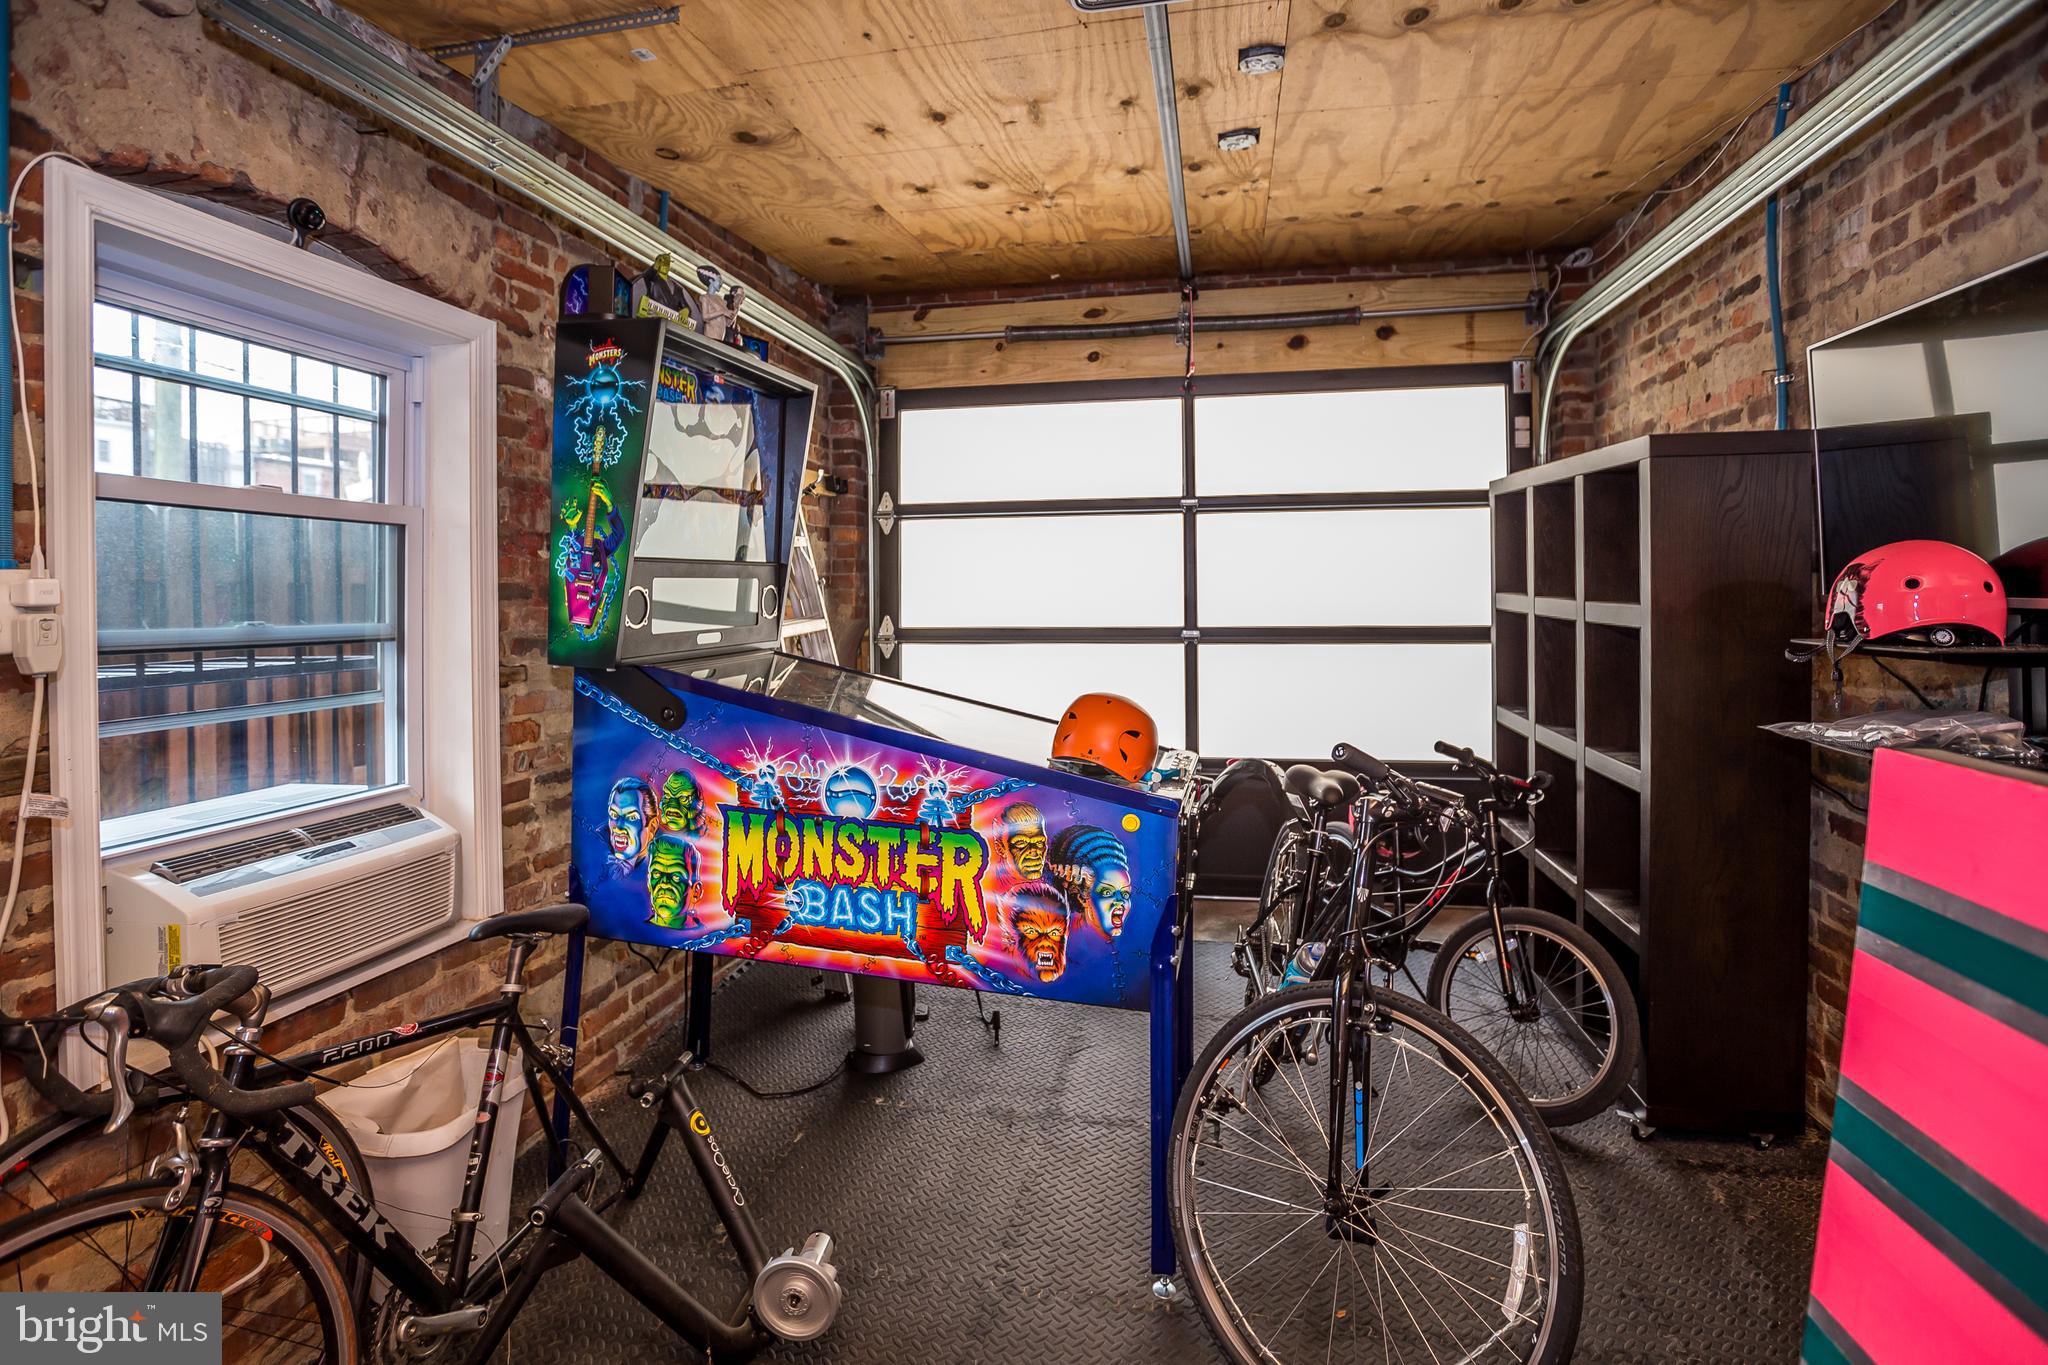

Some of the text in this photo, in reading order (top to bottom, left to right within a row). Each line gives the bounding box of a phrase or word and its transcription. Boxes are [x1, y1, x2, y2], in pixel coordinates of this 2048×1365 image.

[659, 365, 696, 404] NSTER
[723, 807, 987, 940] MONSTER
[801, 882, 912, 934] BASH
[280, 1121, 396, 1250] TREK
[707, 1135, 745, 1206] CycleOps
